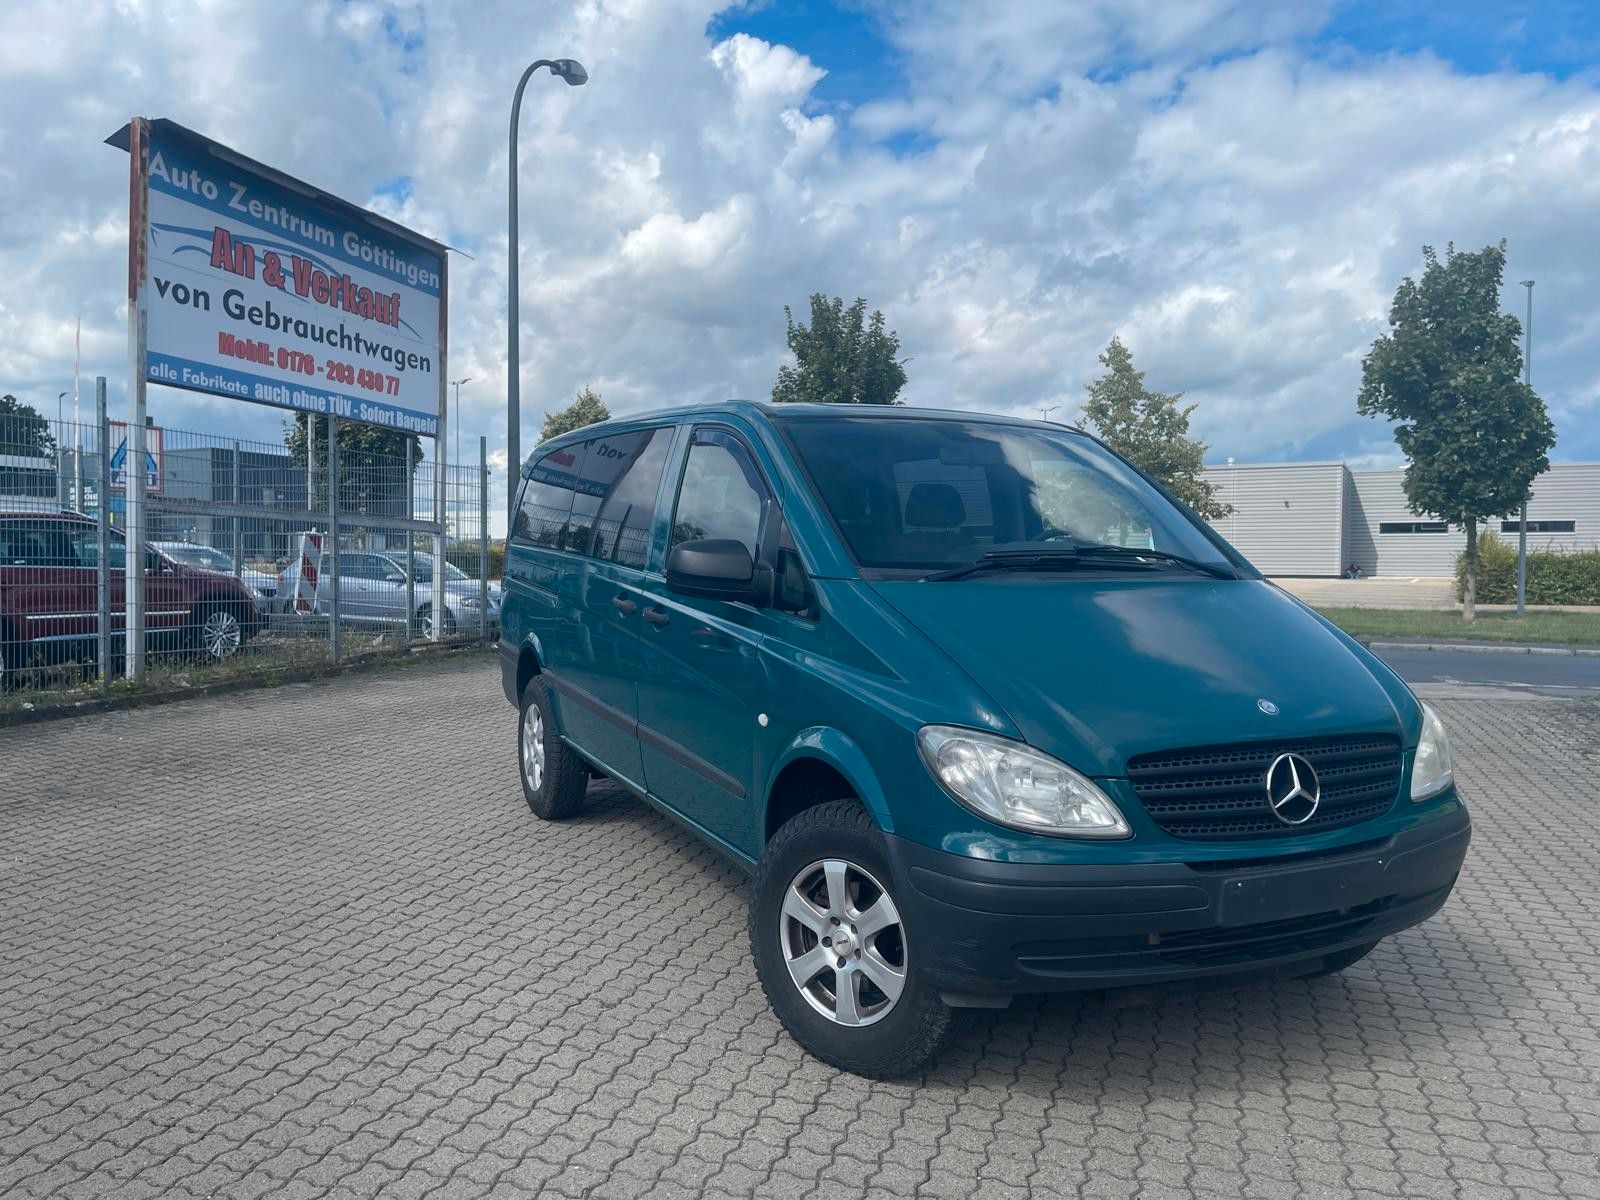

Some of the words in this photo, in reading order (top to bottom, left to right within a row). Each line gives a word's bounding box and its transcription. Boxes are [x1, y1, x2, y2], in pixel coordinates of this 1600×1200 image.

[148, 150, 218, 201] Auto
[228, 181, 335, 248] Zentrum
[342, 231, 440, 289] Göttingen
[153, 276, 210, 311] von
[222, 288, 431, 373] Gebrauchtwagen
[210, 226, 256, 280] An
[263, 250, 286, 291] &
[291, 255, 401, 329] Verkauf
[150, 362, 178, 379] alle
[182, 367, 249, 395] Fabrikate
[254, 382, 290, 404] auch
[292, 390, 326, 412] ohne
[328, 393, 352, 417] TÜV
[360, 403, 395, 426] Sofort
[396, 411, 437, 433] Bargeld
[218, 331, 275, 367] Mobil:
[277, 347, 315, 376] 0176
[326, 359, 355, 385] 203
[385, 374, 400, 396] 77
